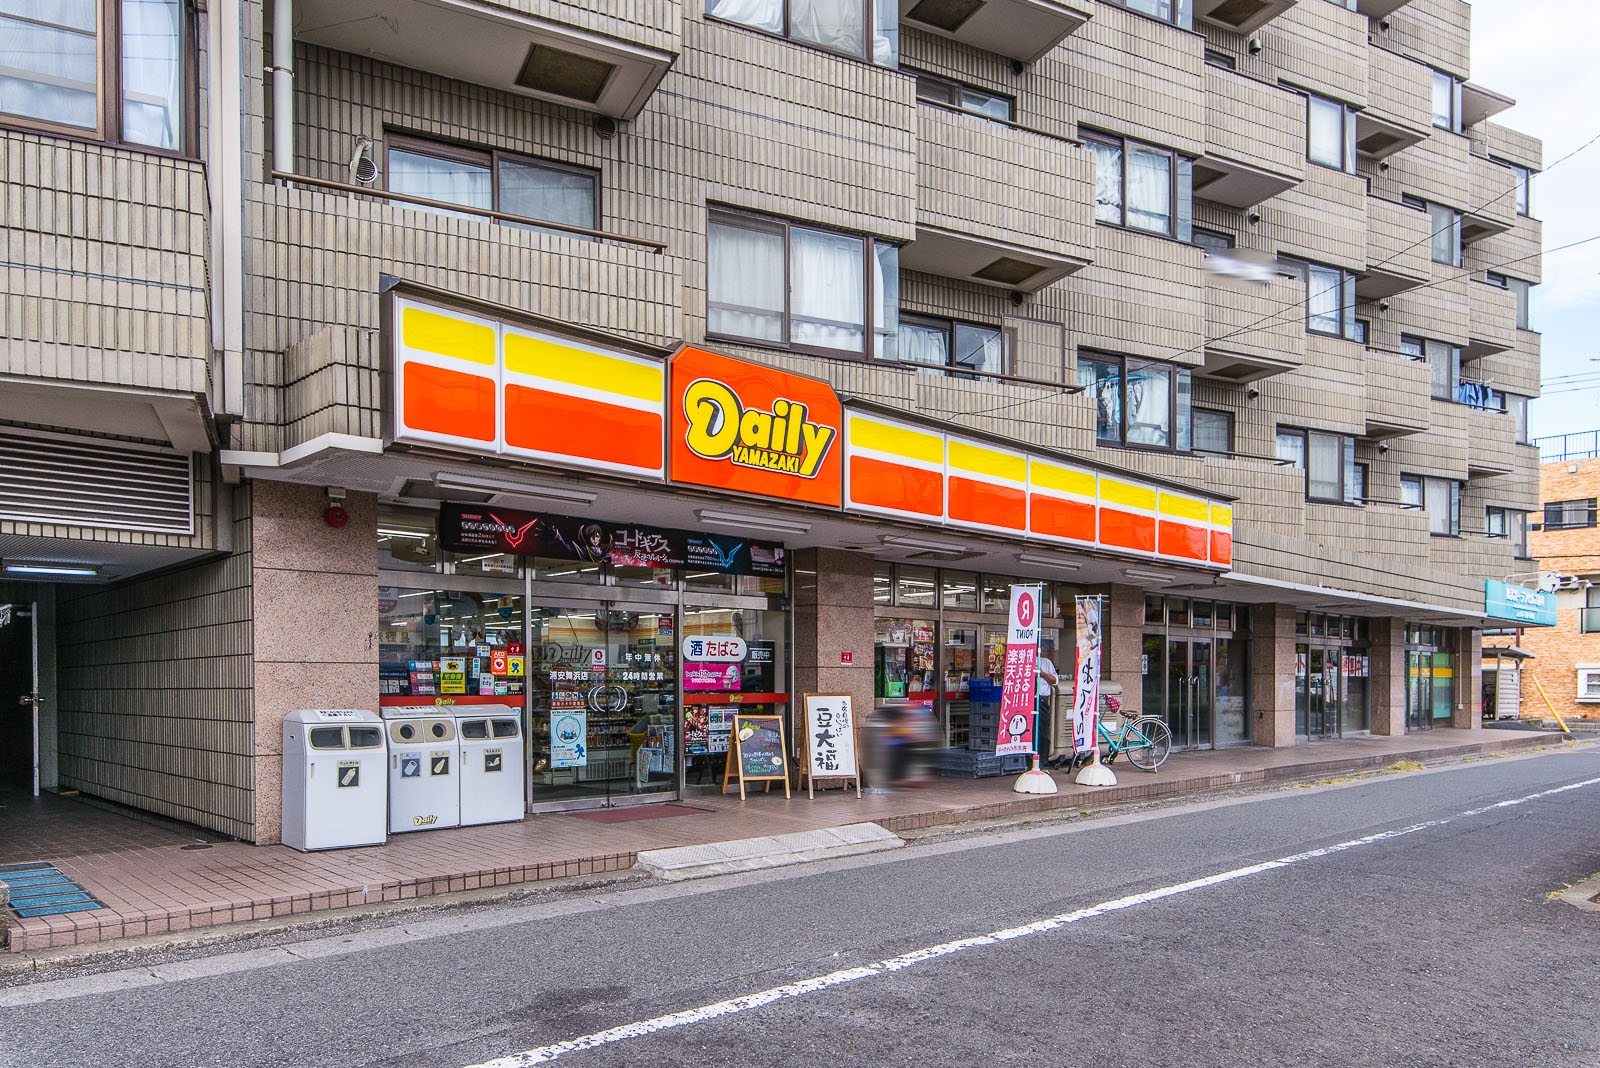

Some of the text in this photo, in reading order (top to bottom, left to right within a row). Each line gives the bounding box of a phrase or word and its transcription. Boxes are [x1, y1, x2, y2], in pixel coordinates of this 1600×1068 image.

[684, 378, 836, 478] Daily
[732, 445, 800, 473] YAMAZAKI
[614, 529, 671, 552] コードギアス
[546, 642, 592, 664] Daily
[690, 640, 740, 657] 酒 たばこ
[435, 698, 456, 706] Daily
[814, 707, 839, 771] 豆大福
[413, 814, 438, 826] Daily
